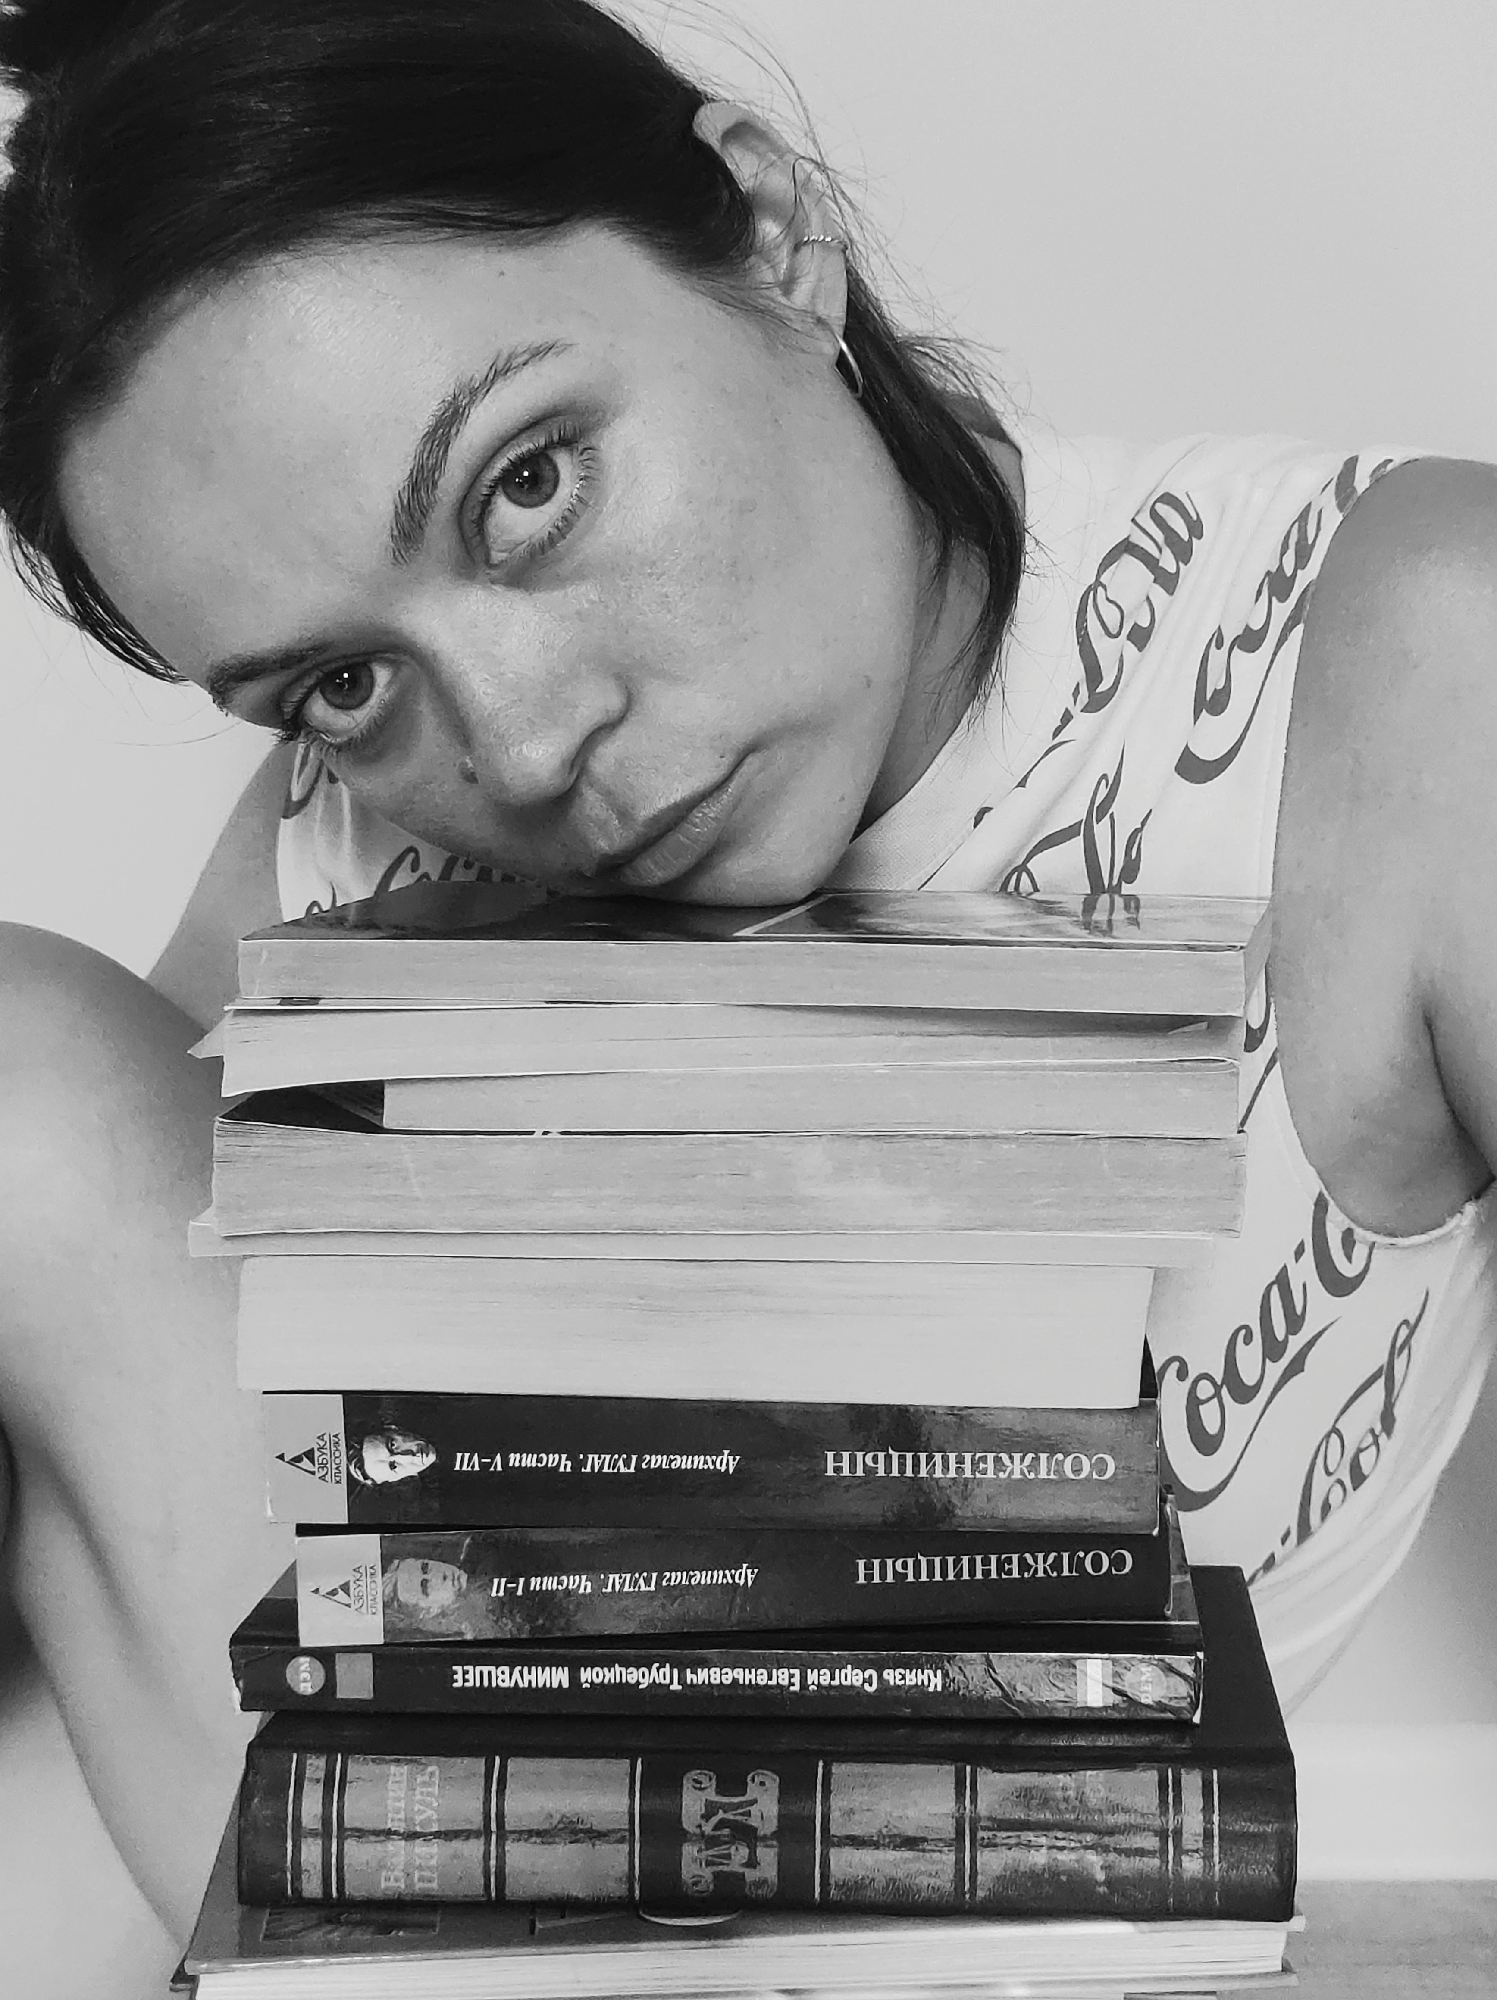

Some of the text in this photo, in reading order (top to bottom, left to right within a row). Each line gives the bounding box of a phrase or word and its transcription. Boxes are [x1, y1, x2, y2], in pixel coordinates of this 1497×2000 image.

[316, 1432, 329, 1483] АЗБУКА
[331, 1432, 342, 1484] КЛАССИКА
[508, 1451, 573, 1471] Части
[579, 1453, 639, 1473] ГУЛАГ.
[642, 1449, 741, 1475] Архипелаг
[823, 1445, 1117, 1480] СОЛЖЕНИЦЫН
[599, 1571, 659, 1592] ГУЛАГ.
[661, 1563, 759, 1589] Архипелаг
[855, 1548, 1134, 1585] СОЛЖЕНИЦЫН
[352, 1564, 365, 1615] АЗБУКА
[529, 1573, 593, 1595] Части
[297, 1657, 313, 1692] ДЭМ
[451, 1662, 943, 1693] Князь Сергей Евгеньевич Трубецкой МИНУВШЕЕ
[1139, 1666, 1153, 1705] DEM
